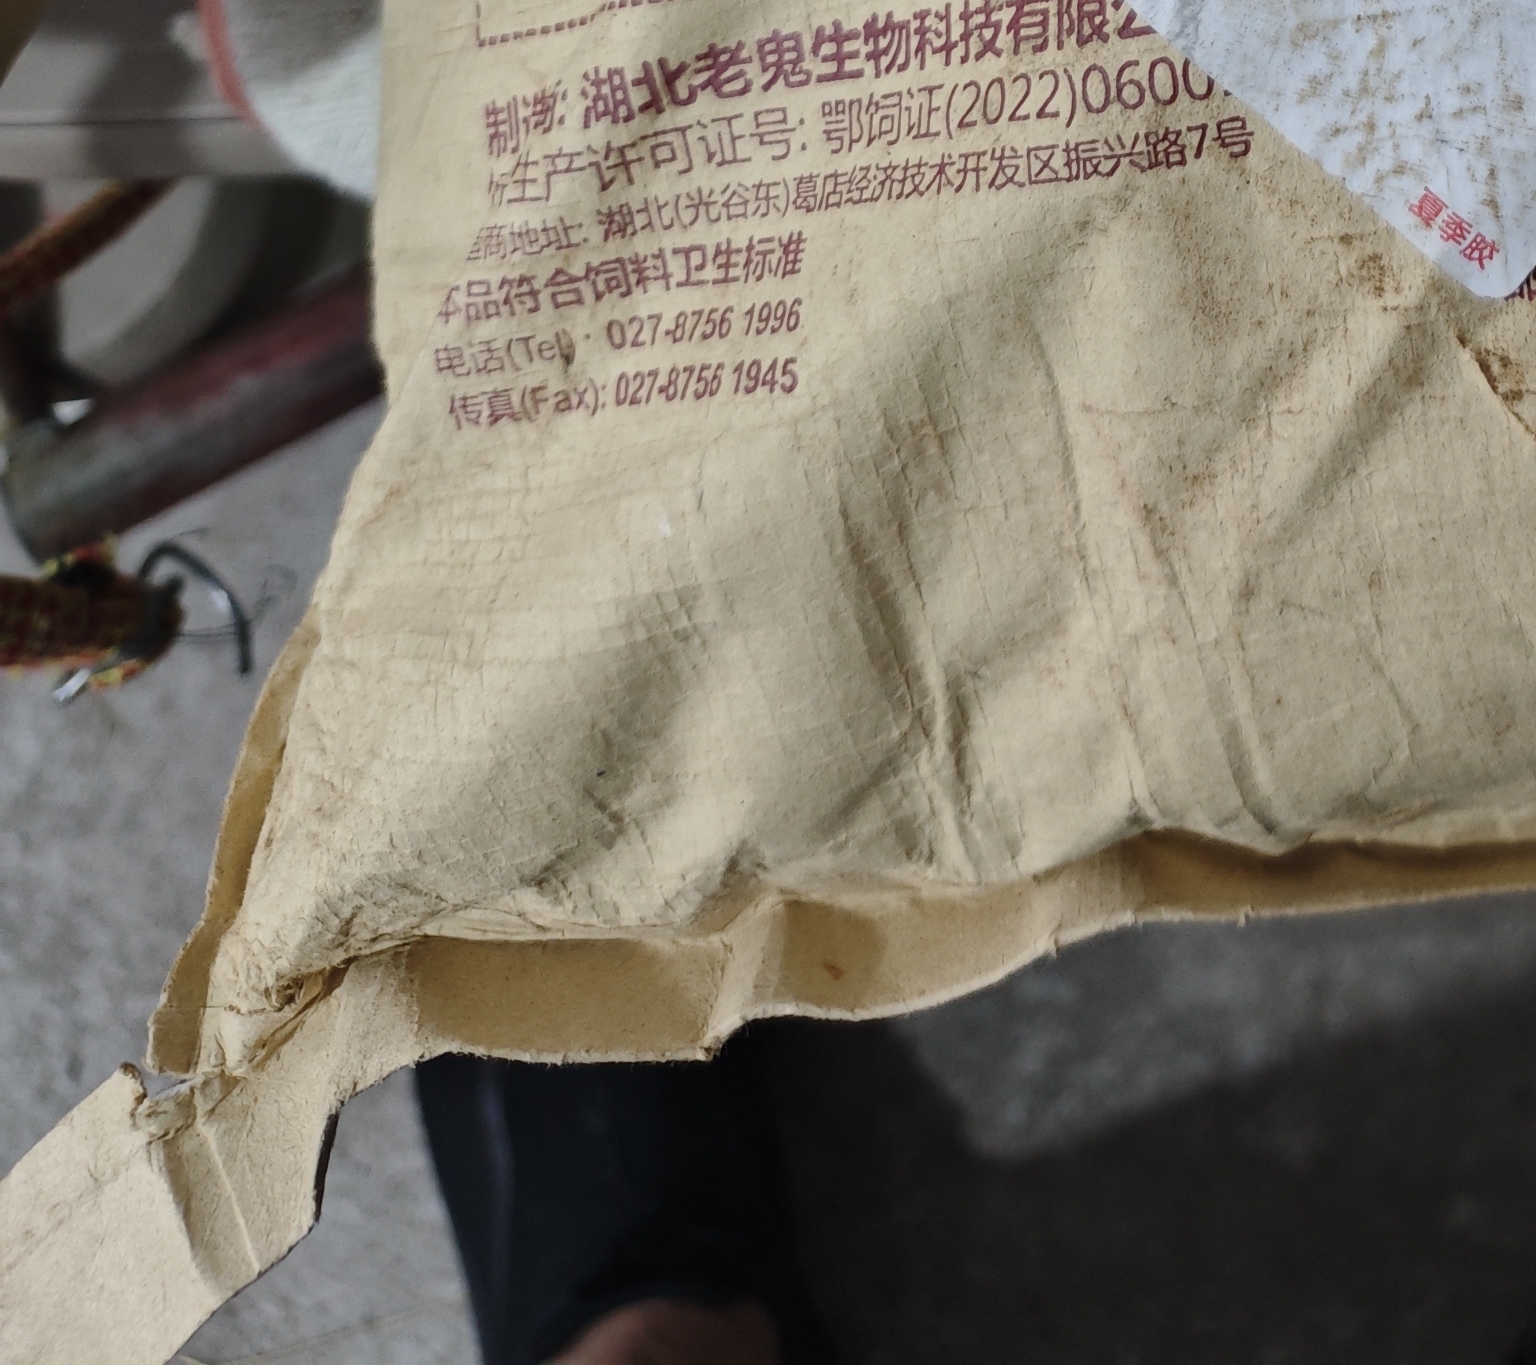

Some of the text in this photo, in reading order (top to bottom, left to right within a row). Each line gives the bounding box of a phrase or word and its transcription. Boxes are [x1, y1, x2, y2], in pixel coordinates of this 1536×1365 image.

[1409, 188, 1500, 273] 夏季胶
[744, 297, 803, 337] 1996
[732, 355, 800, 395] 1945
